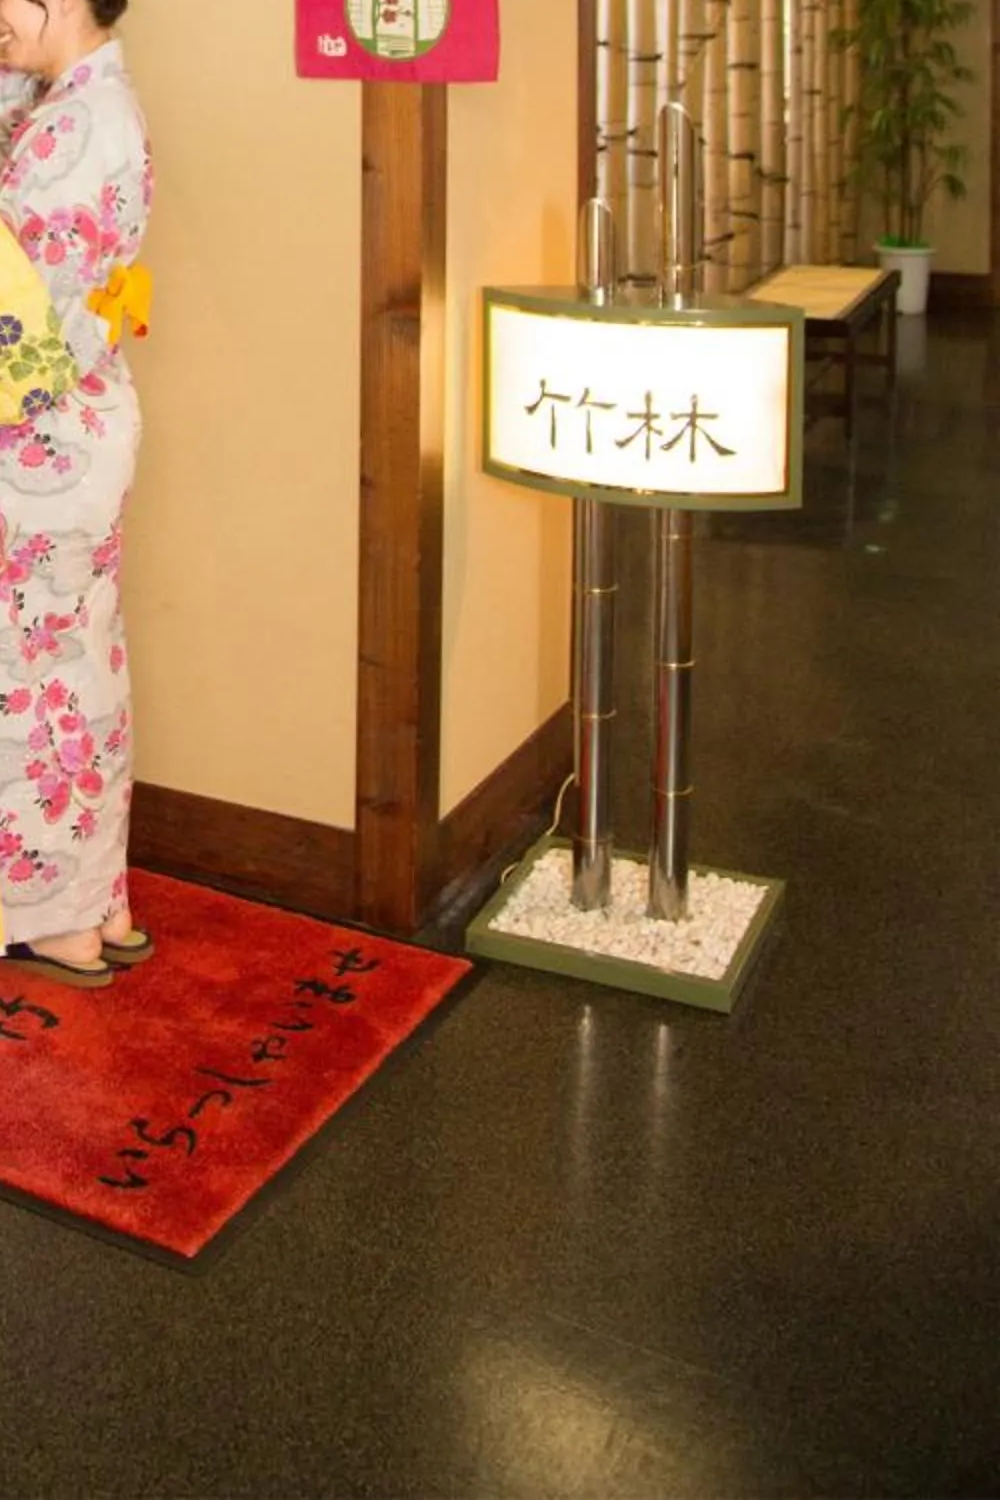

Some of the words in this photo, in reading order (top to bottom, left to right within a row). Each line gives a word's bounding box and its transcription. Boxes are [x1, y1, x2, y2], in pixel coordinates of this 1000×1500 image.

[525, 379, 737, 462] 竹林
[99, 948, 379, 1190] いらっしゃいませ
